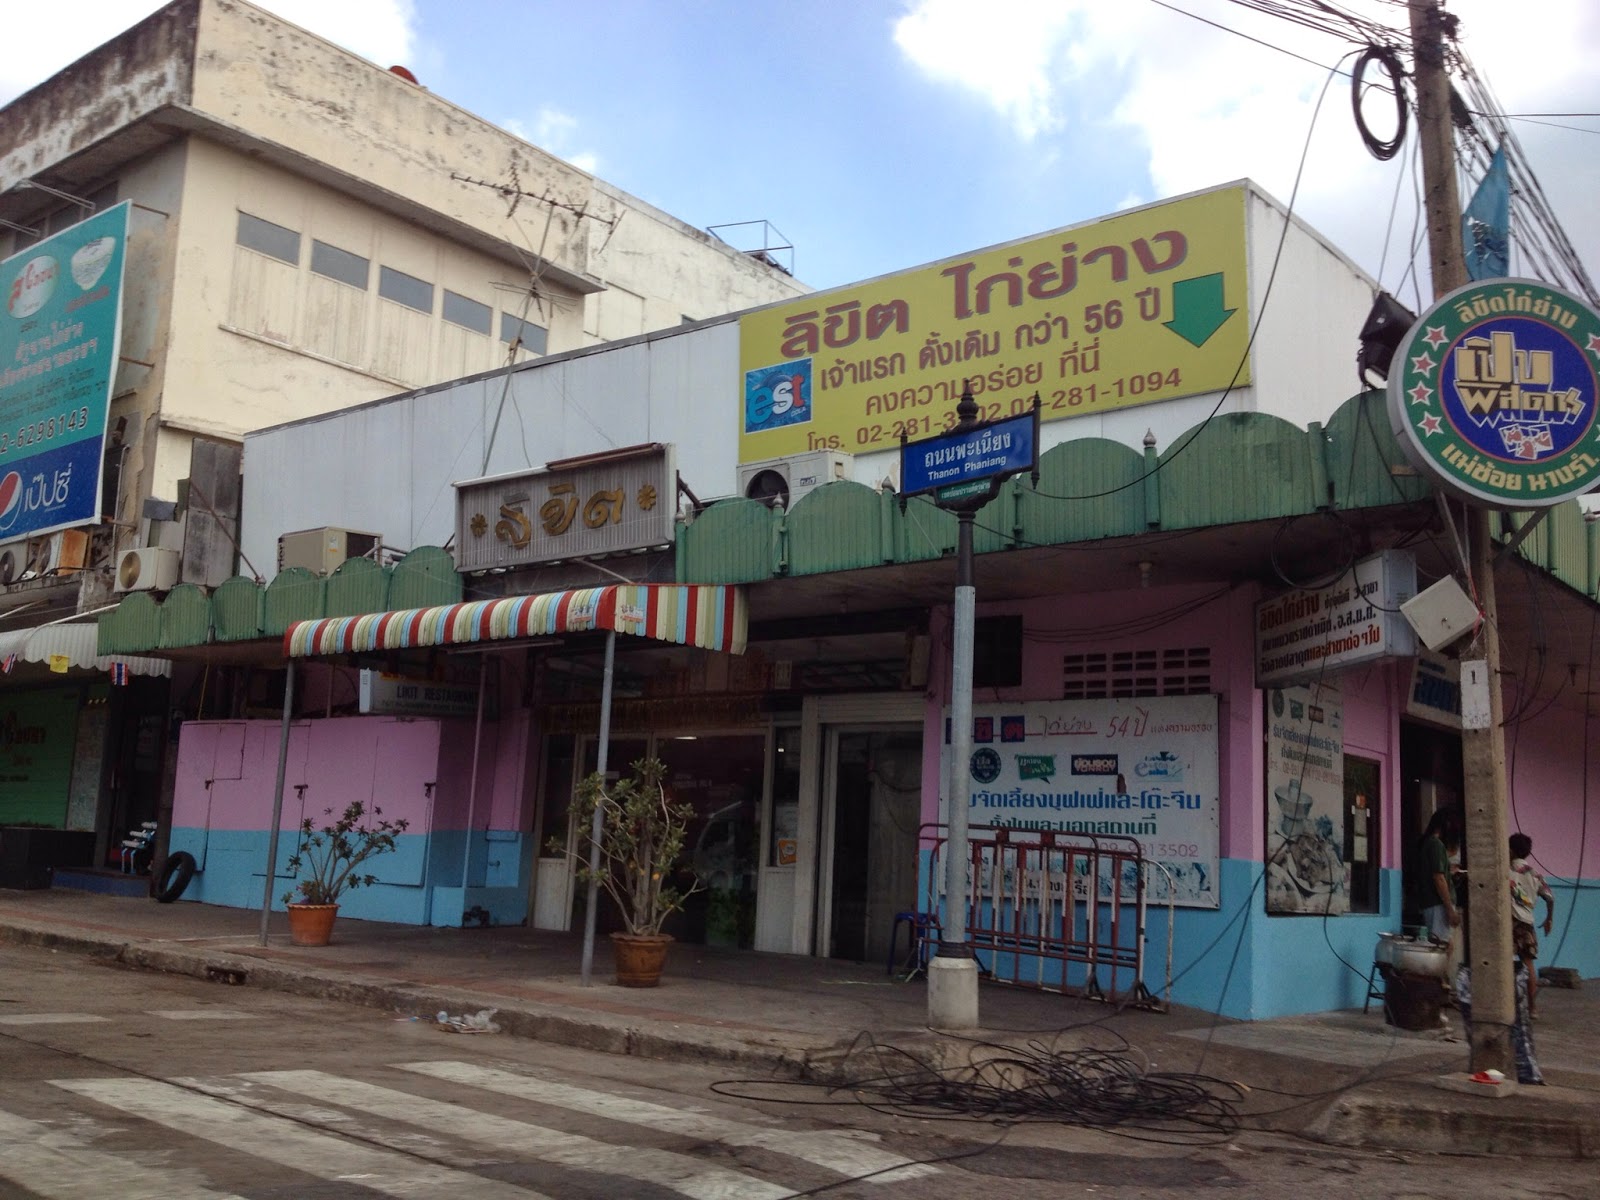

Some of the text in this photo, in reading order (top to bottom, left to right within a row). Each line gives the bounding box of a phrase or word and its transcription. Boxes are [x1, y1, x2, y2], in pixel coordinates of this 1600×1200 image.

[780, 229, 1188, 358] ลิขิต ไก่ย่าง
[1454, 288, 1579, 329] ลิขิตไก่ย่าง
[821, 351, 906, 391] เจ้าแรก
[1014, 312, 1069, 350] กว่า
[1084, 300, 1123, 333] 56
[1135, 287, 1162, 321] ปี
[750, 374, 804, 424] est
[866, 337, 1101, 416] คงความอร่อย ที่นี่
[925, 430, 1011, 468] ถนนพะเนียง
[928, 456, 1007, 481] Thanon Phaniang
[1106, 714, 1130, 738] 54
[1134, 706, 1150, 738] ปี
